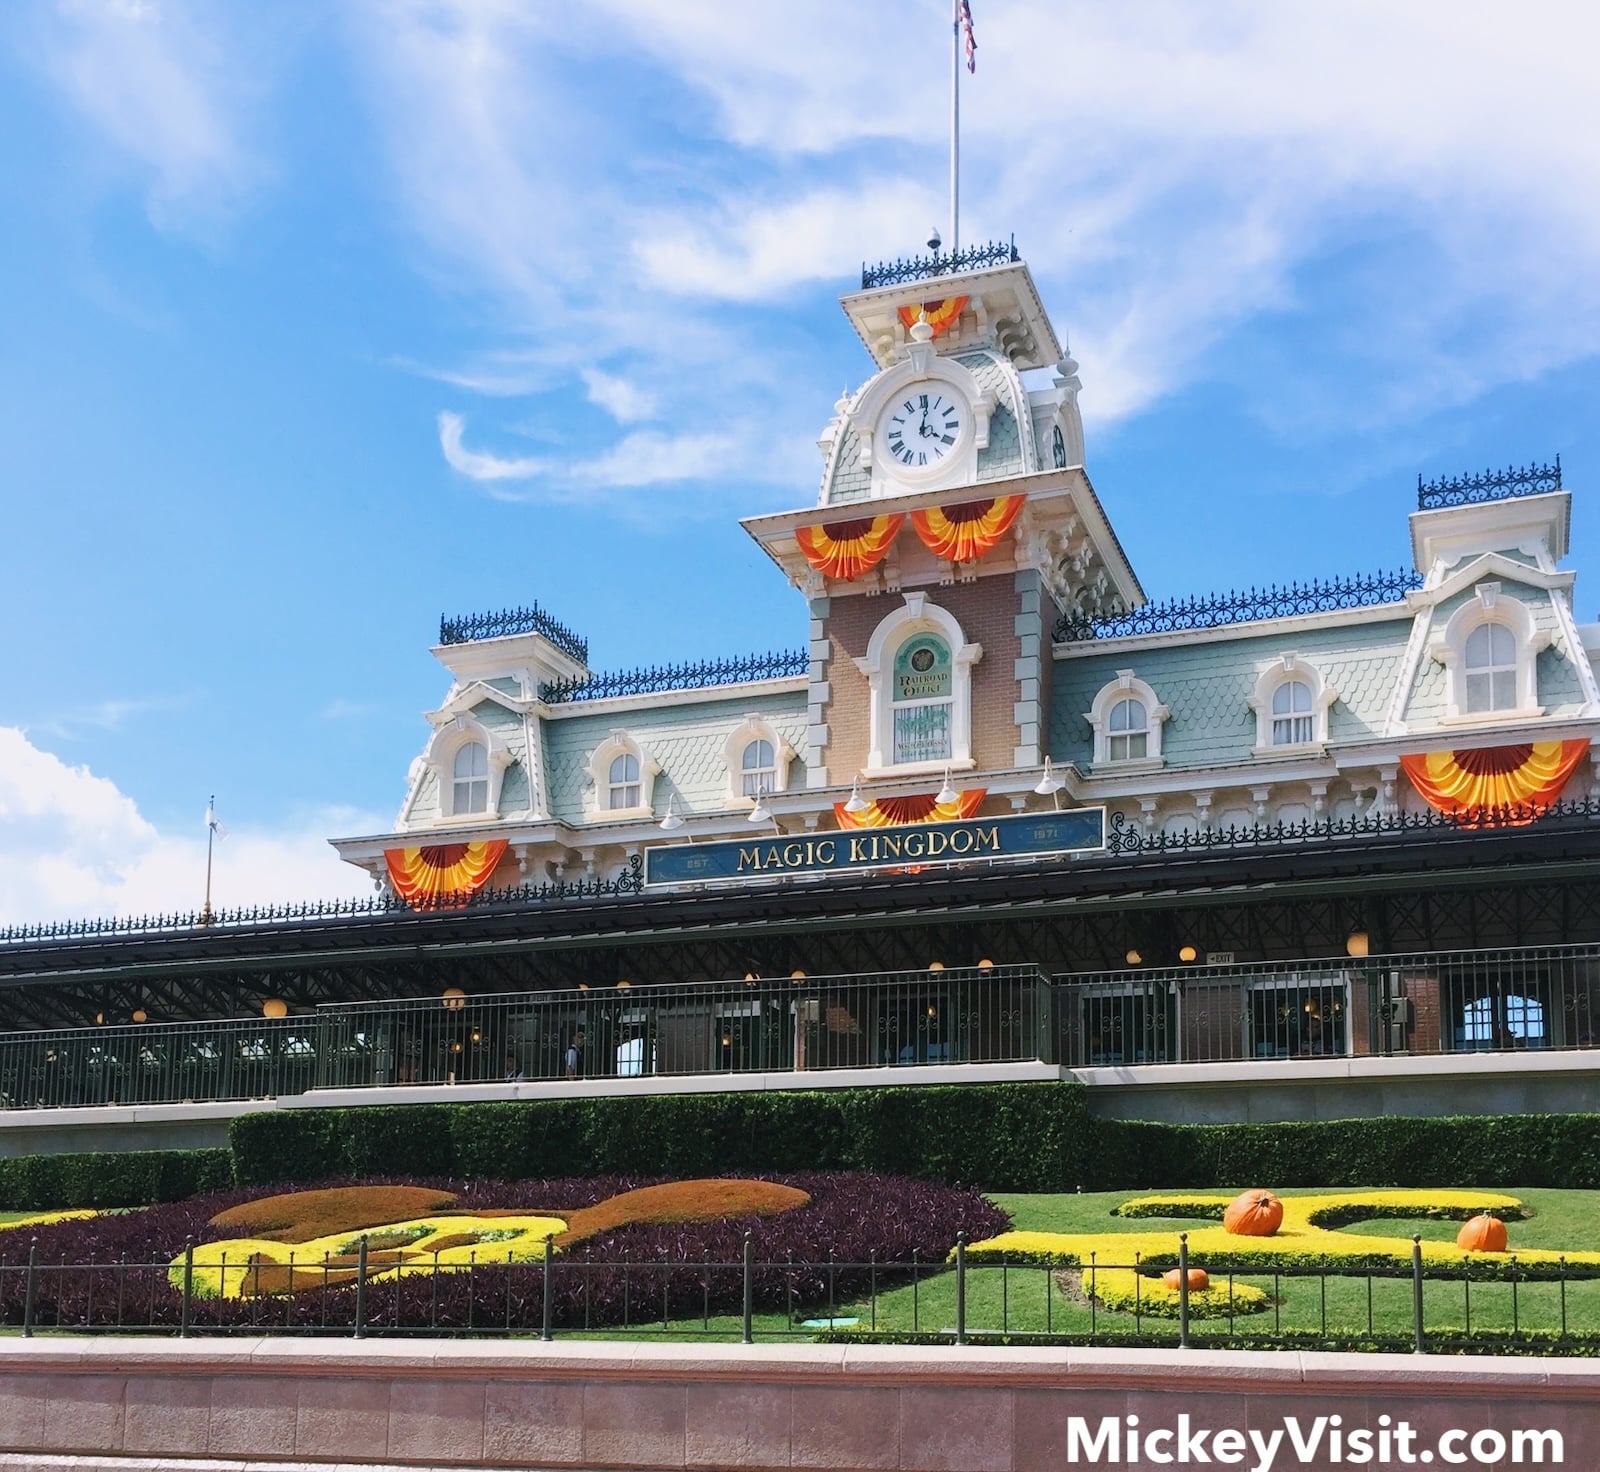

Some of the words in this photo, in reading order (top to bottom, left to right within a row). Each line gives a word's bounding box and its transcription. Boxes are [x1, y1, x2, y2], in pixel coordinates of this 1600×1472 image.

[737, 840, 836, 871] MAGIC
[850, 826, 1001, 862] KINGDOM
[1033, 828, 1058, 840] 1971
[1215, 954, 1232, 963] EXIT
